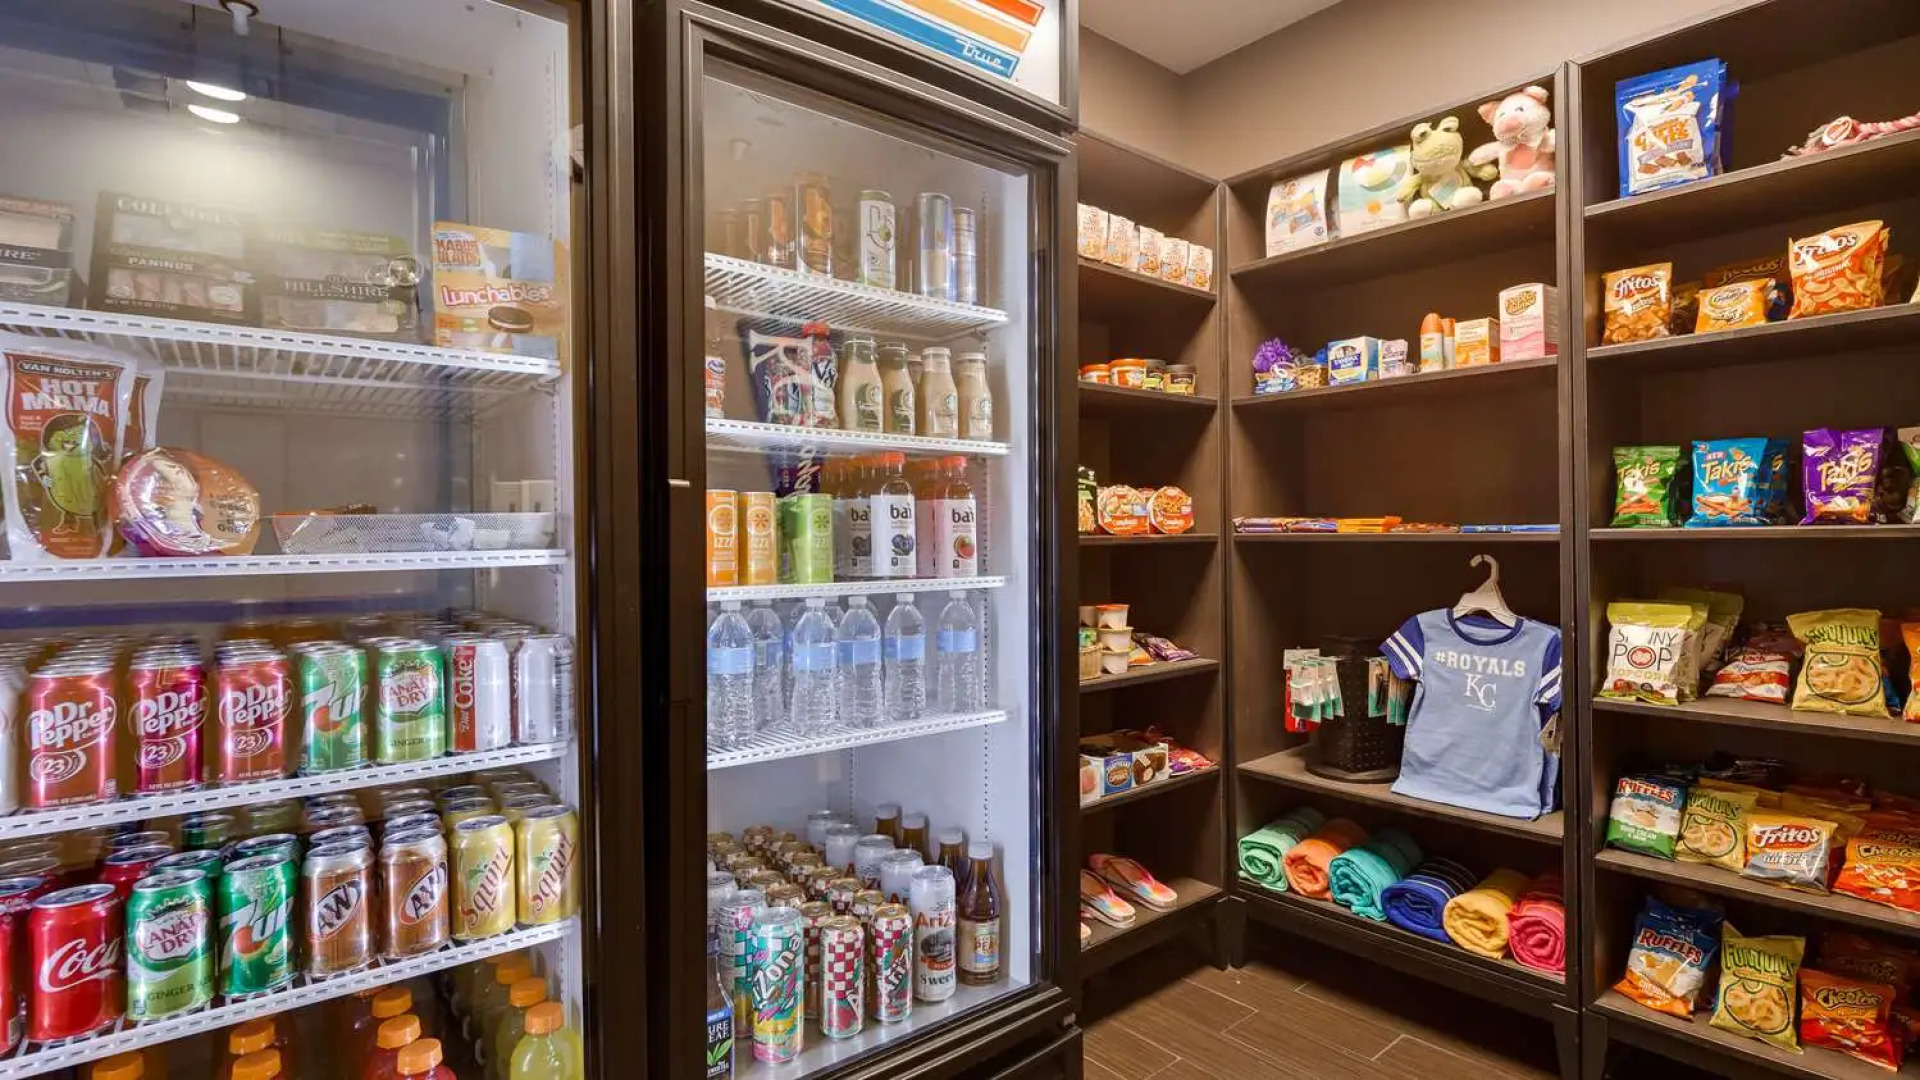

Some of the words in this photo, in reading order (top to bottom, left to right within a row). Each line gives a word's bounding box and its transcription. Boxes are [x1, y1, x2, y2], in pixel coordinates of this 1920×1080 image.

[441, 283, 553, 306] Lunchables
[41, 378, 99, 396] HOT
[21, 392, 109, 416] MAMA
[1618, 460, 1660, 489] Takis
[1433, 651, 1527, 677] #ROYALS
[1612, 643, 1672, 671] POP
[246, 684, 279, 705] Dr
[454, 658, 474, 709] Coke
[1464, 673, 1497, 709] KC
[54, 701, 93, 726] Dr
[157, 690, 193, 713] Dr
[226, 689, 293, 728] Pepper
[30, 706, 114, 750] Pepper
[136, 696, 208, 735] Pepper
[1752, 827, 1820, 847] Fritos
[1636, 927, 1702, 964] RUFFLES
[1814, 987, 1883, 1009] Cheetos
[708, 1019, 730, 1034] URE
[708, 1031, 730, 1043] EAF
